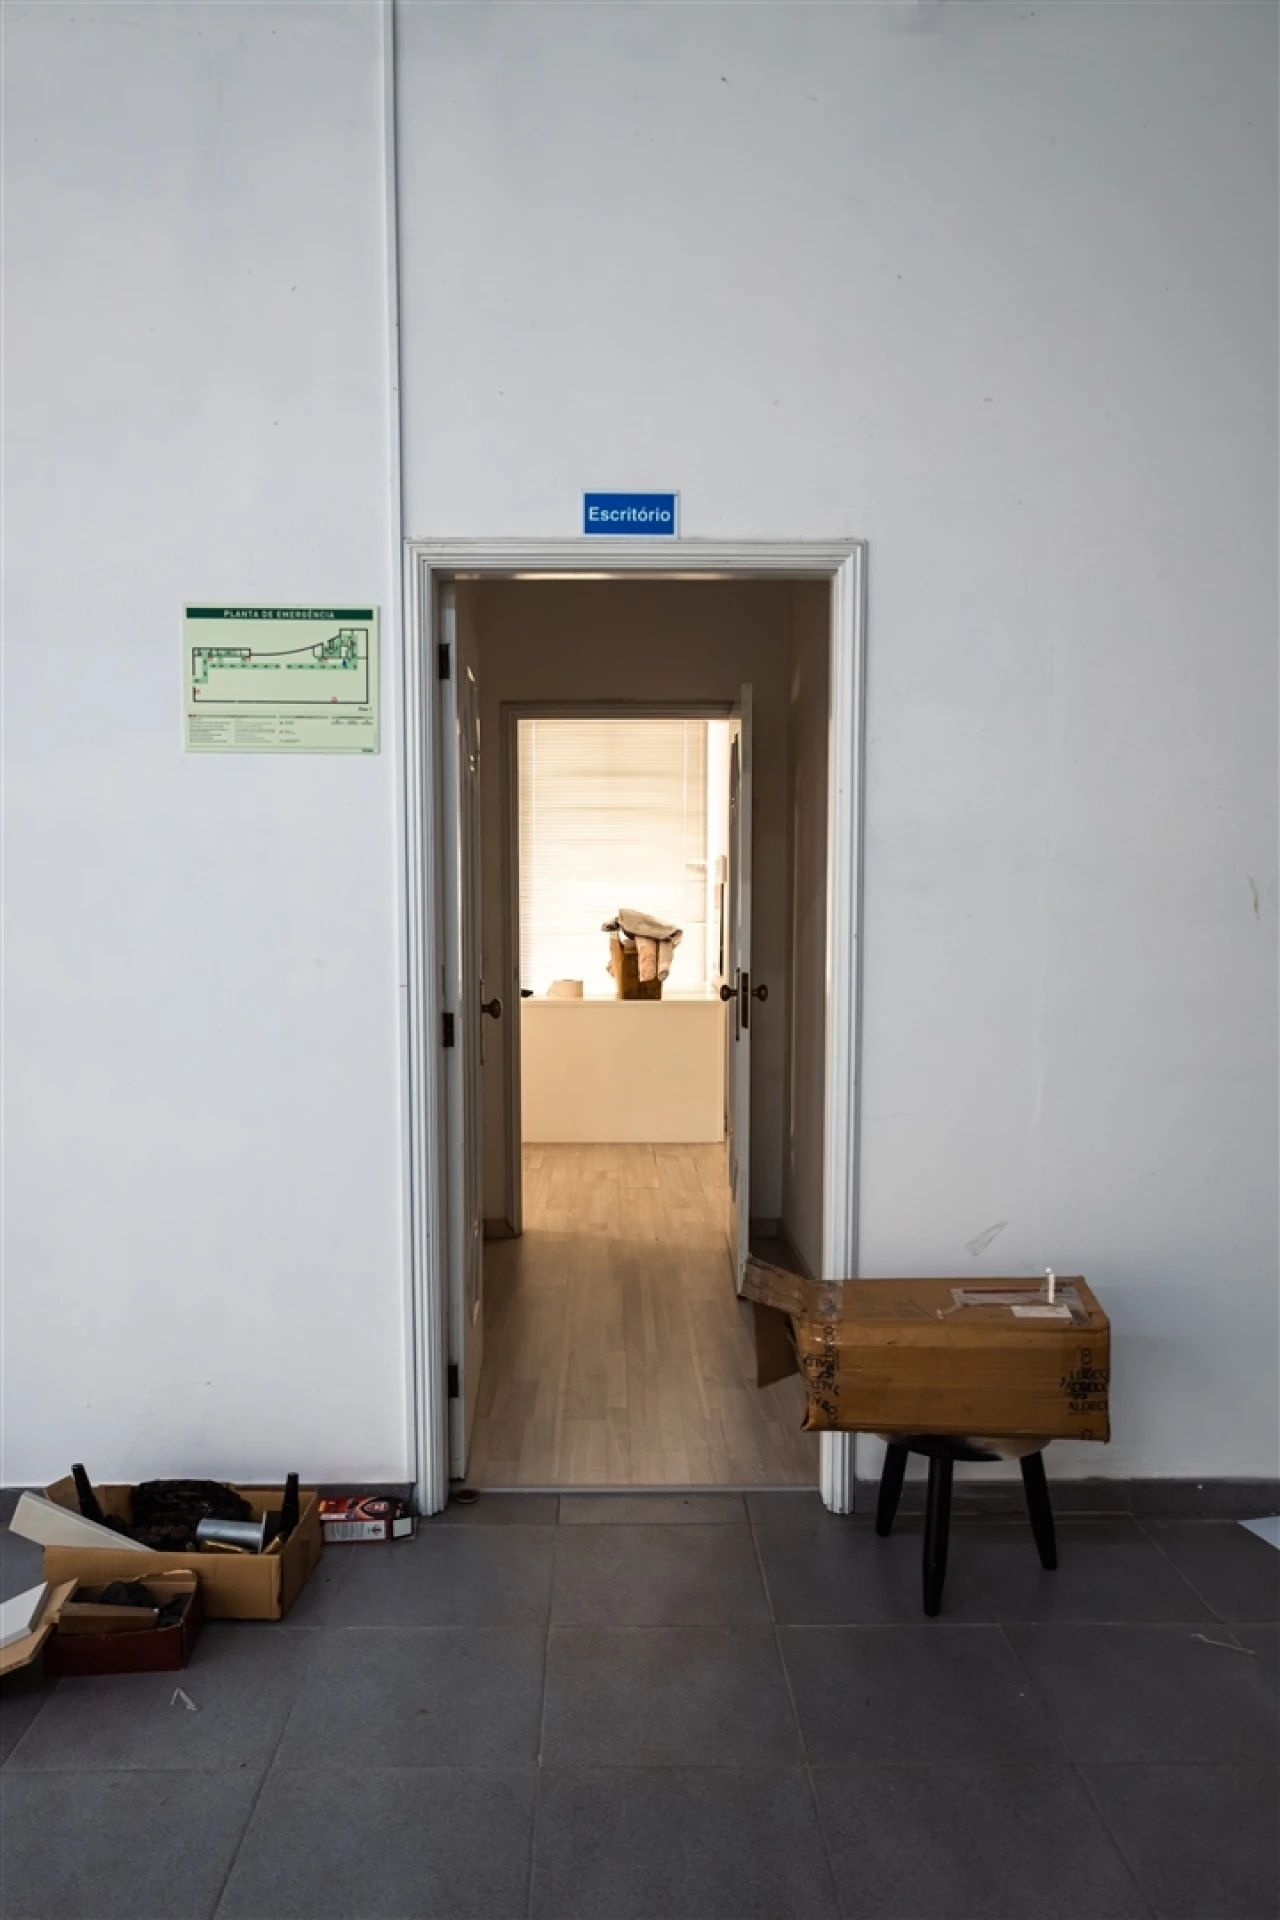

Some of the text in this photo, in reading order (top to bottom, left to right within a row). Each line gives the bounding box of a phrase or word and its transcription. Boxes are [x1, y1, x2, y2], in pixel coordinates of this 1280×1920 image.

[589, 506, 671, 522] Escritório
[223, 608, 335, 619] PLANTA DE EMERGÊNCIA
